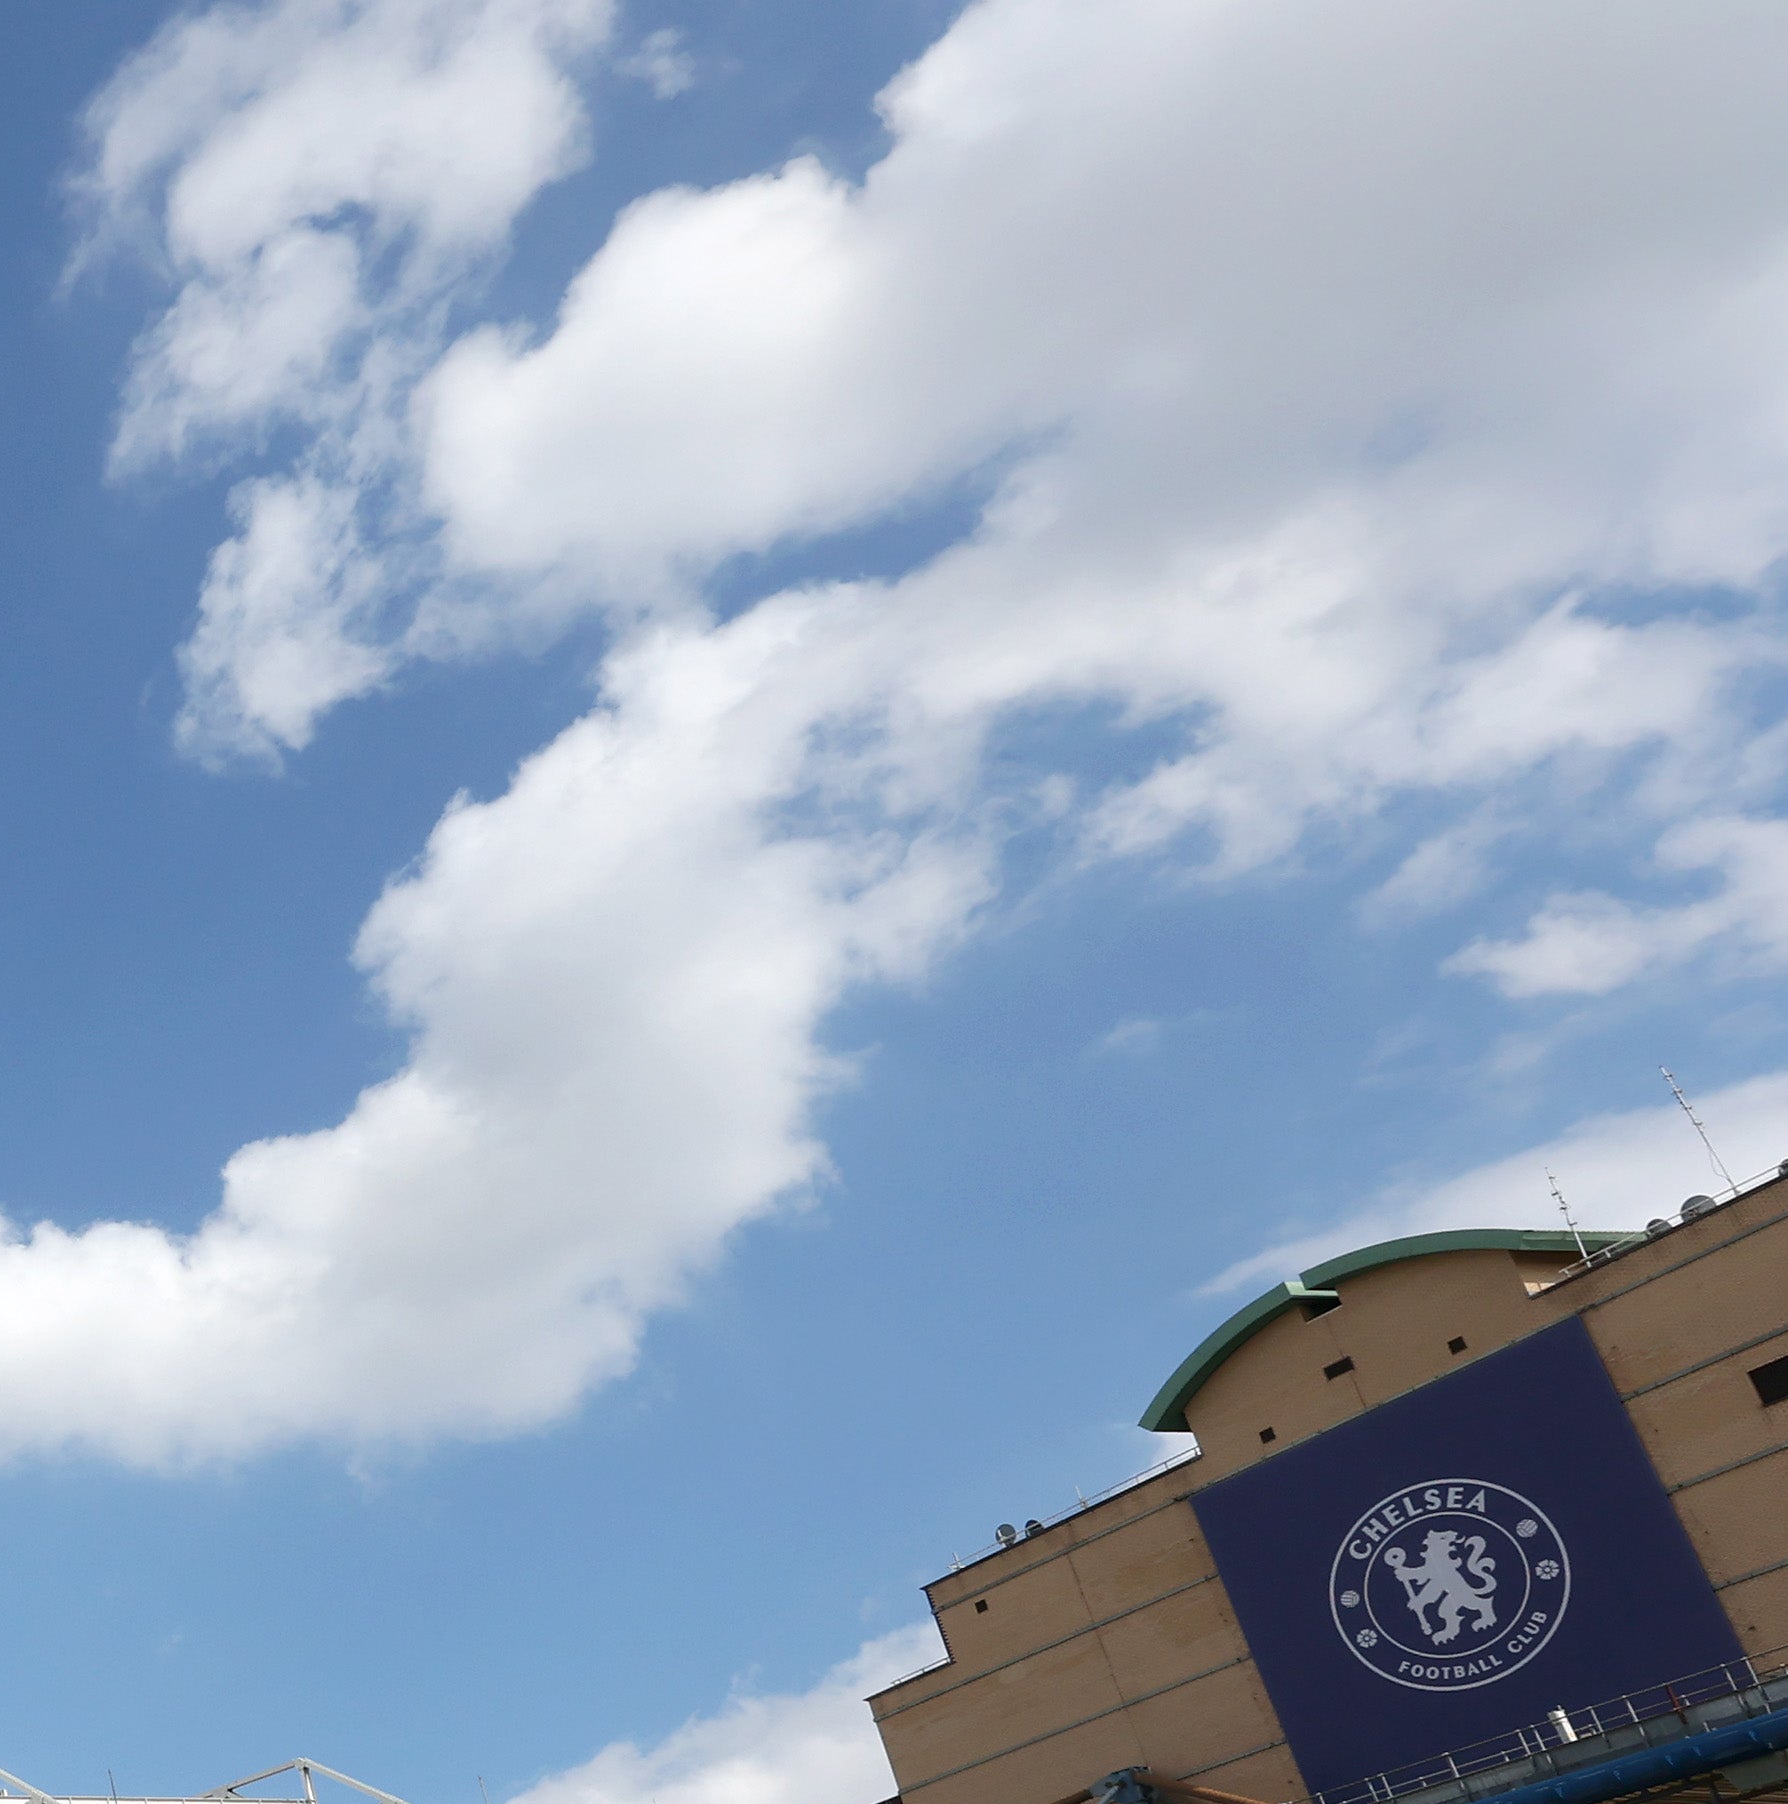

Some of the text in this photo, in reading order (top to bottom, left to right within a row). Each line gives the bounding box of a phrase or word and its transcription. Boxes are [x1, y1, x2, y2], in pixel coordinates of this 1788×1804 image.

[1350, 1487, 1487, 1560] CHELSEA
[1398, 1610, 1548, 1679] FOOTBALL CLUB
